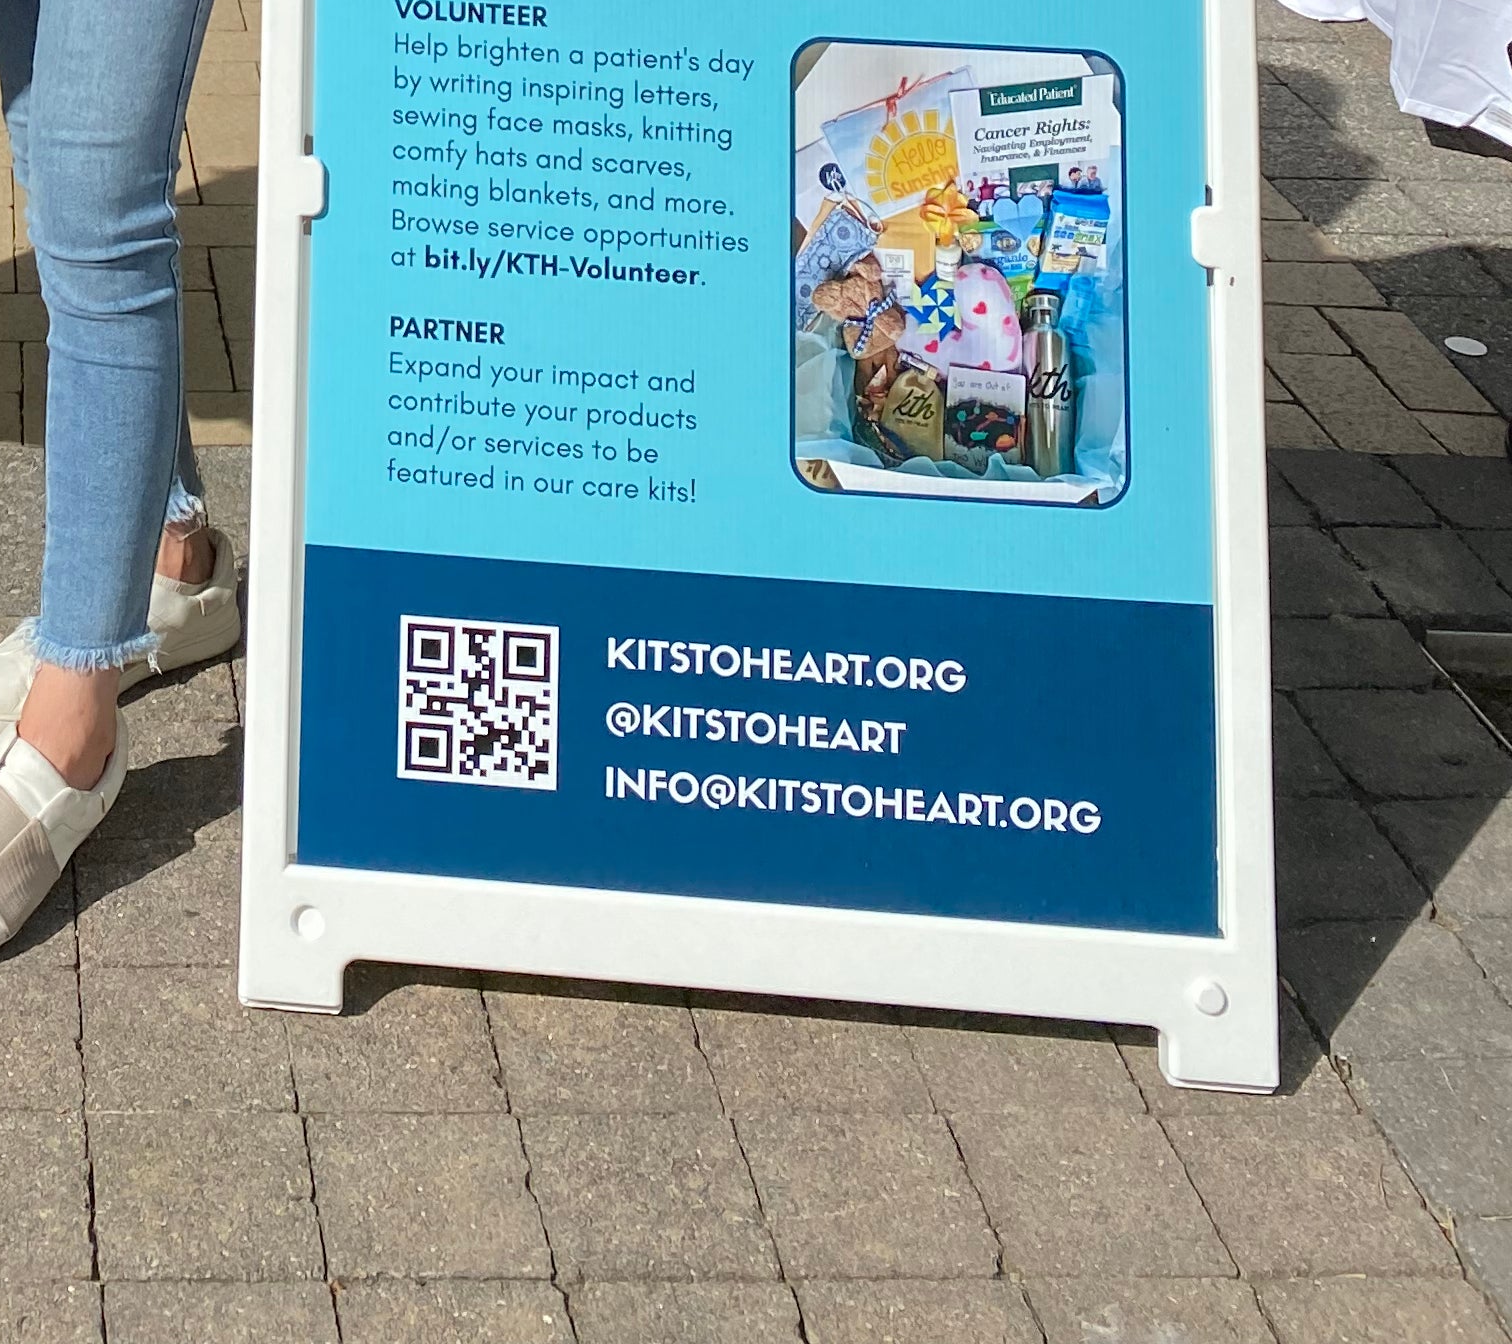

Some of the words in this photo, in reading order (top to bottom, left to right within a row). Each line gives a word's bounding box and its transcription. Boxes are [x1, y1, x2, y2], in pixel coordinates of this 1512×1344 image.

[394, 31, 449, 64] Help
[457, 34, 560, 67] brighten
[568, 49, 584, 65] a
[593, 46, 700, 73] patient's
[708, 48, 755, 82] day
[394, 65, 422, 98] by
[429, 73, 512, 103] writing
[522, 76, 624, 110] inspiring
[634, 79, 718, 112] letters,
[990, 89, 1037, 106] Educated
[392, 107, 478, 137] sewing
[487, 106, 544, 133] face
[553, 112, 633, 143] masks,
[642, 115, 733, 152] knitting
[973, 141, 1026, 155] Navigating
[1030, 134, 1092, 148] Employment,
[975, 126, 1030, 141] Cancer
[1035, 118, 1091, 136] Rights:
[392, 139, 468, 171] comfy
[476, 140, 528, 168] hats
[535, 146, 583, 171] and
[591, 157, 692, 182] scarves,
[892, 138, 947, 175] Hello
[392, 173, 479, 207] making
[489, 176, 599, 212] blankets,
[607, 186, 655, 211] and
[664, 196, 734, 216] more.
[392, 208, 480, 236] Browse
[487, 220, 575, 242] service
[583, 227, 749, 253] opportunities
[390, 247, 417, 267] at
[425, 244, 706, 286] bit.ly/KTH-Volunteer.
[390, 315, 506, 345] PARTNER
[389, 351, 481, 383] Expand
[490, 365, 544, 388] your
[552, 364, 640, 394] impact
[647, 369, 695, 394] and
[1029, 363, 1072, 402] kth
[388, 390, 516, 418] contribute
[524, 403, 578, 427] your
[586, 402, 697, 431] products
[893, 389, 934, 420] kth
[387, 423, 477, 455] and/or
[484, 436, 584, 459] services
[591, 439, 617, 461] to
[627, 440, 659, 464] be
[386, 457, 494, 489] featured
[504, 470, 524, 492] in
[533, 477, 575, 495] our
[582, 480, 639, 499] care
[648, 476, 696, 504] kits!
[607, 636, 967, 693] KITSTOHEART.ORG
[605, 702, 907, 754] @KITSTOHEART
[605, 766, 1102, 834] INFO@KITSTOHEART.ORG
